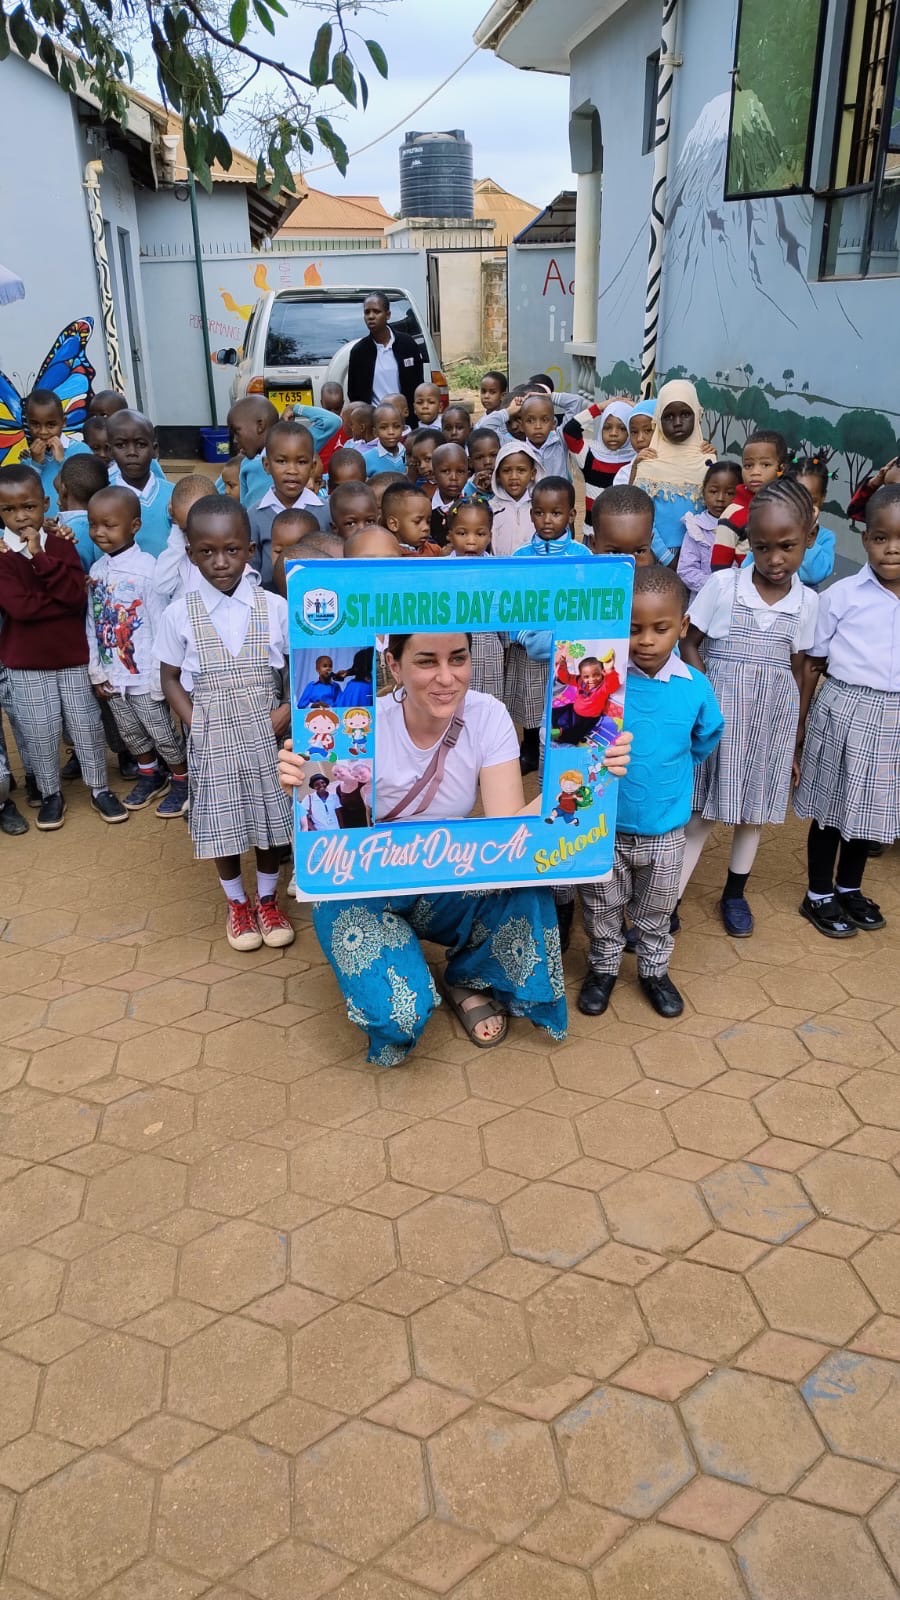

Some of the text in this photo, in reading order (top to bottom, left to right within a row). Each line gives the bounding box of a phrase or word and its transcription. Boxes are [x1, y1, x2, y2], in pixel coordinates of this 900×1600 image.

[456, 590, 496, 625] DAY
[499, 589, 549, 623] CARE
[554, 588, 625, 622] CENTER
[307, 814, 609, 885] My First Day At School
